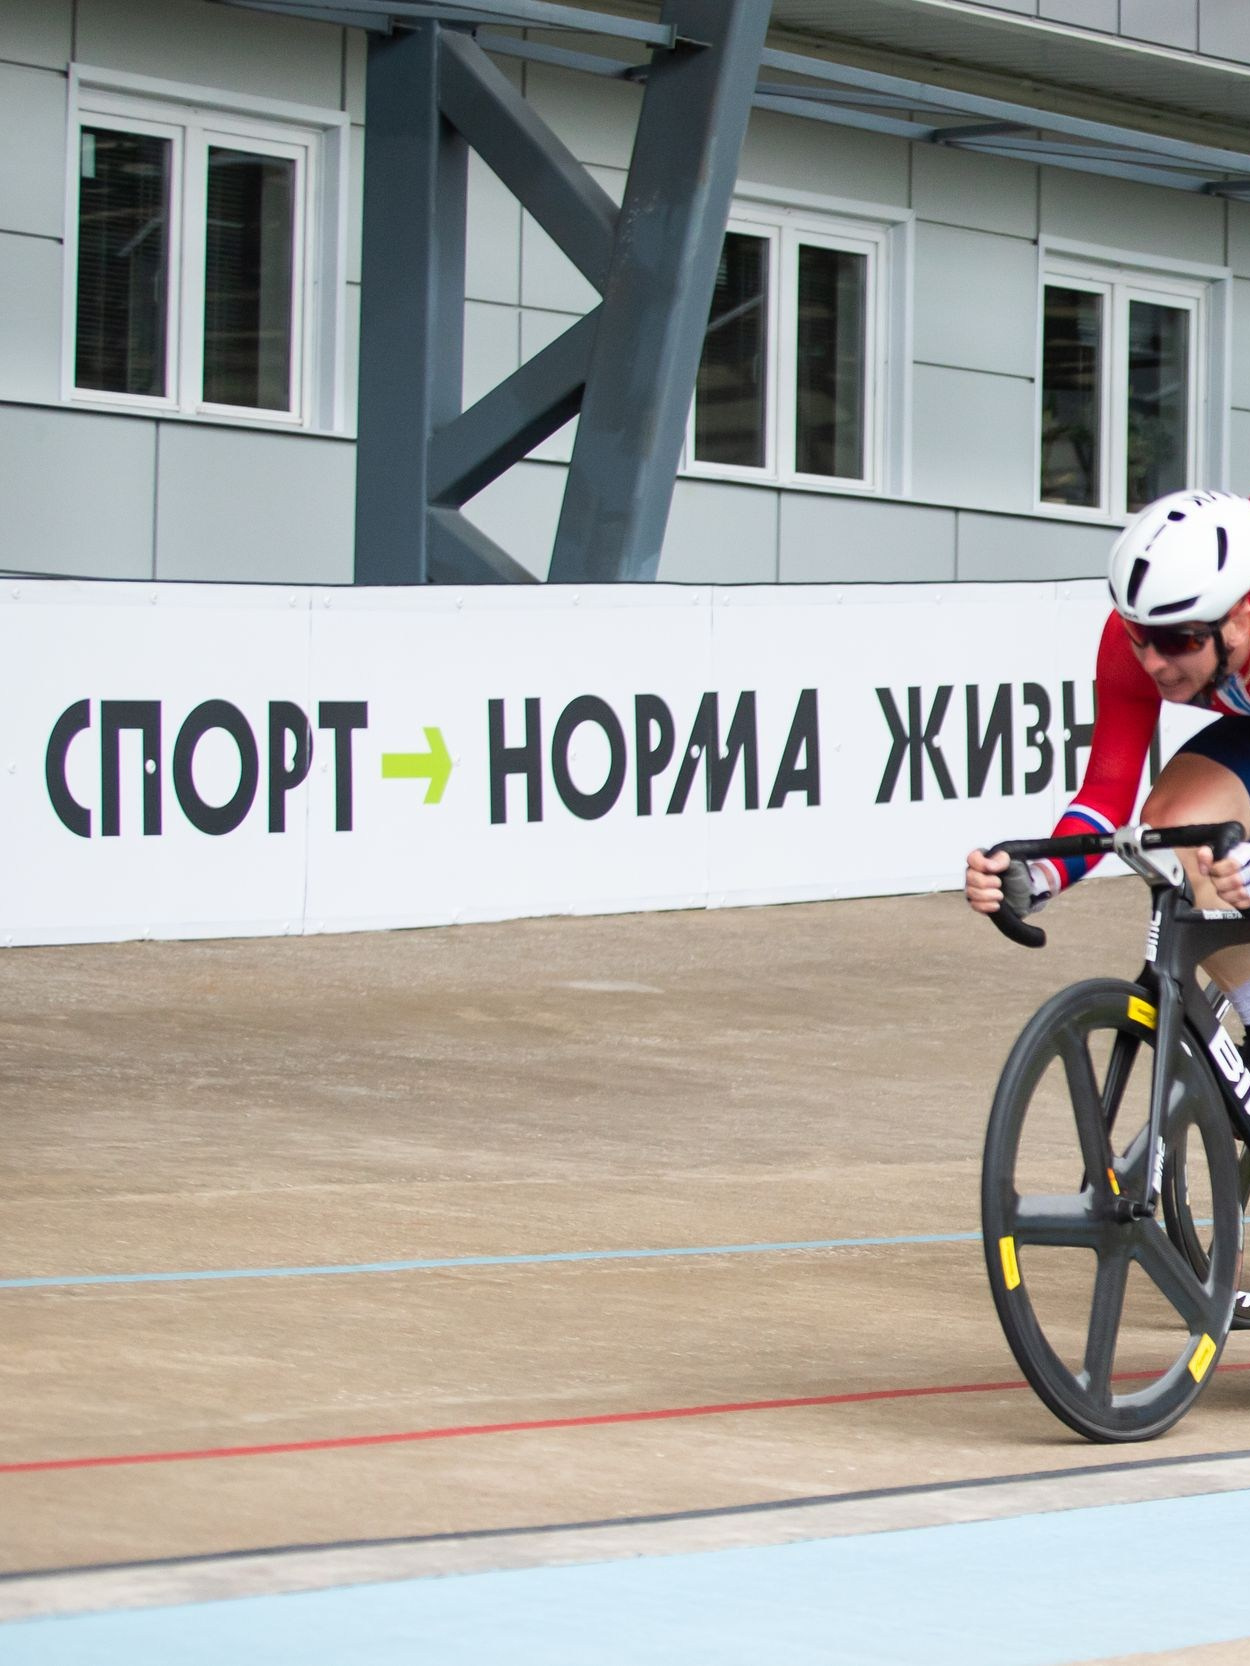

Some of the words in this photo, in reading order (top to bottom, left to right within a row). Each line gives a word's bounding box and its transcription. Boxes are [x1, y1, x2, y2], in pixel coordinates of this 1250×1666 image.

[45, 698, 369, 838] СПОРТ
[488, 688, 821, 825] НОРМА
[875, 681, 1160, 804] ЖИЗН
